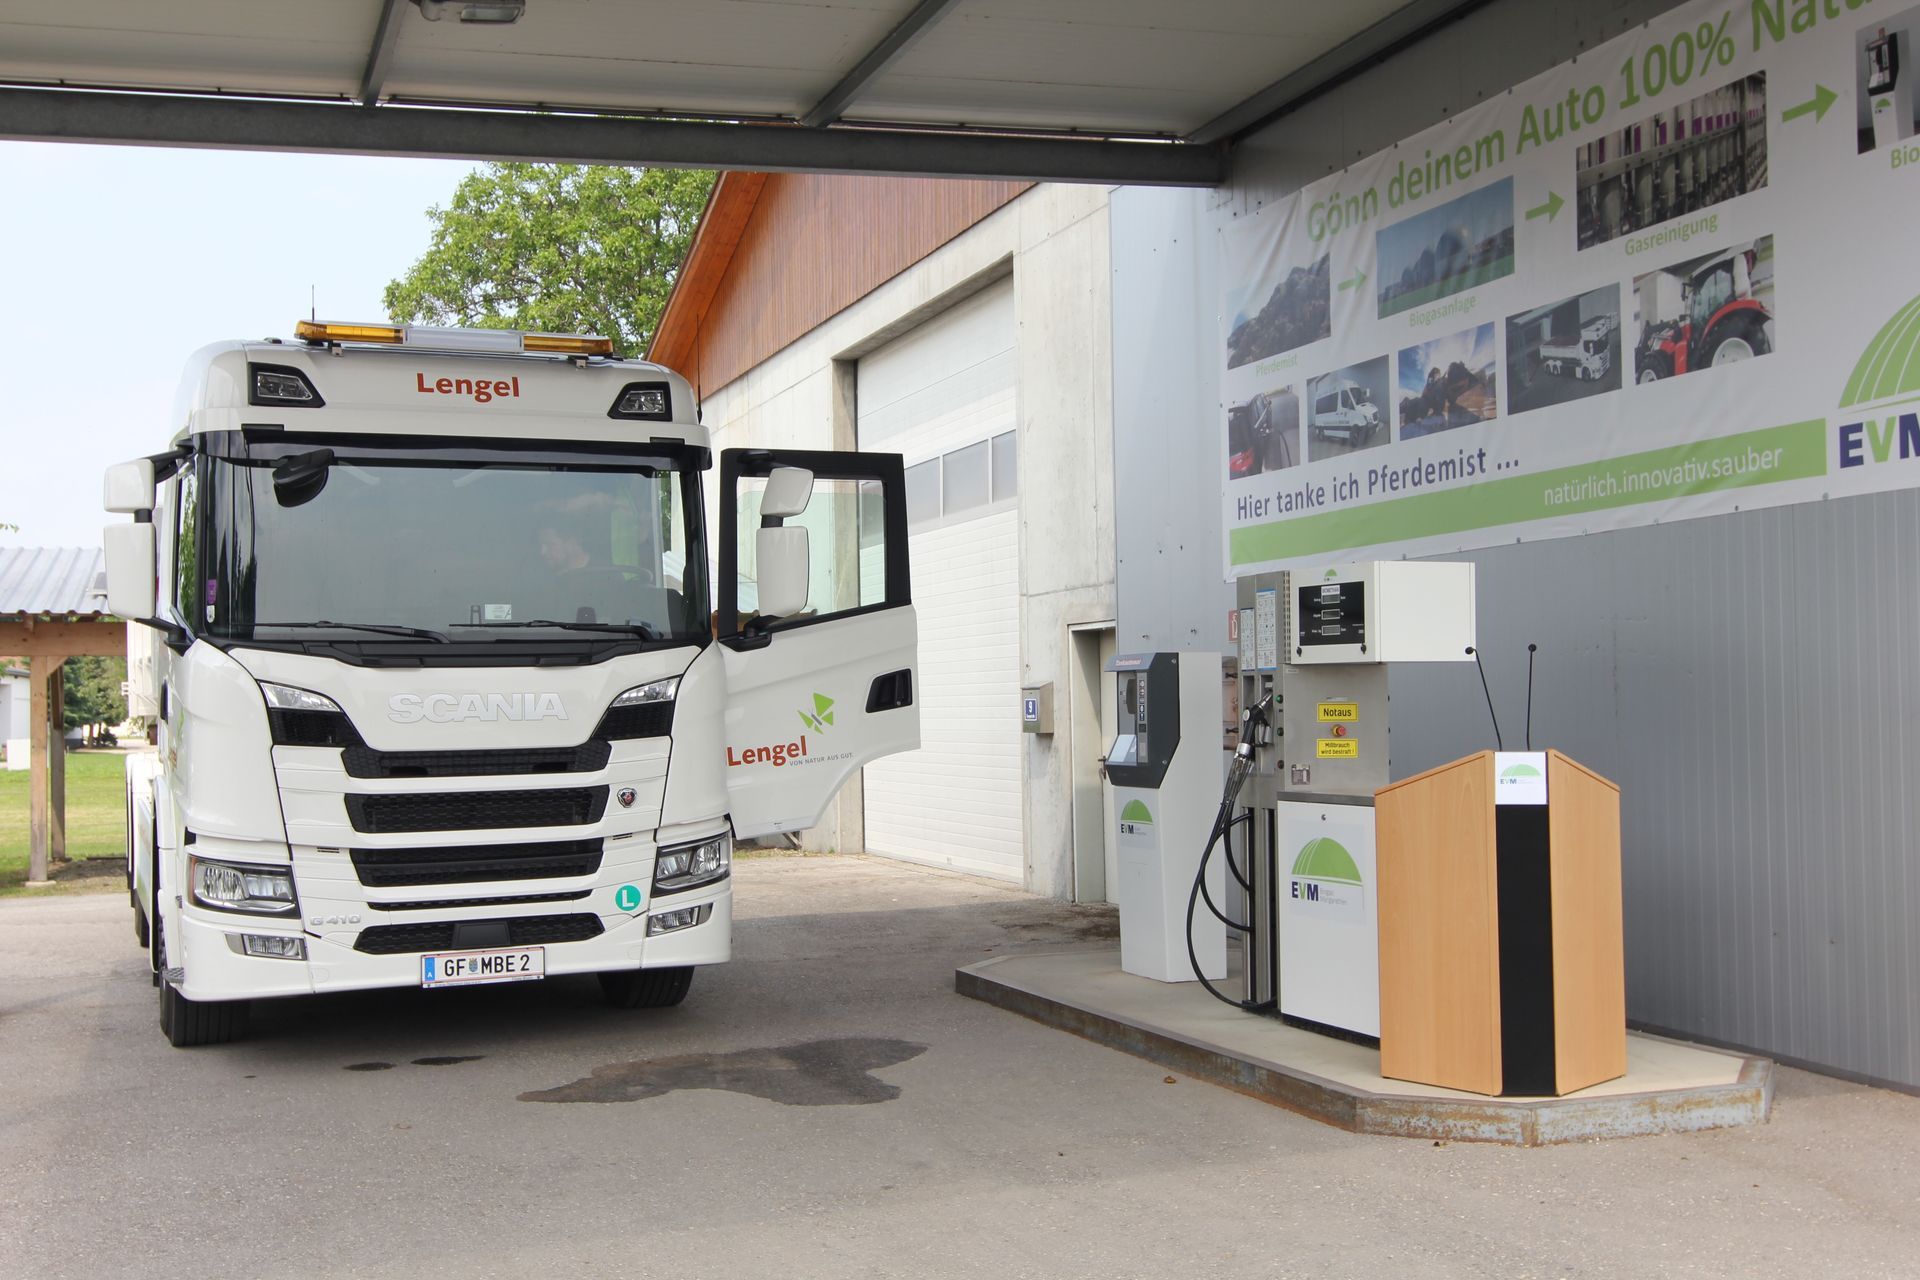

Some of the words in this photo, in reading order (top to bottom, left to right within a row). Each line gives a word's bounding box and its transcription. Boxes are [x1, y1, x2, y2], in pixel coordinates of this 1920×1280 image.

[1307, 186, 1379, 242] Gönn
[1387, 129, 1505, 208] deinem
[1515, 83, 1605, 154] Auto
[1618, 10, 1736, 110] 100%
[1624, 213, 1719, 256] Gasreinigung
[1409, 296, 1477, 328] Biogasanlage
[1255, 352, 1298, 377] Pferdemist
[416, 372, 520, 403] Lengel
[1237, 494, 1270, 520] Hier
[1277, 482, 1325, 513] tanke
[1333, 472, 1359, 502] ich
[1368, 447, 1486, 495] Pferdemist
[1544, 445, 1783, 506] natürlich.innovativ.sauber
[387, 692, 569, 724] SCANIA
[1323, 708, 1352, 717] Notaus
[726, 735, 808, 767] Lengel
[805, 756, 825, 764] NATUR
[622, 890, 634, 907] L
[1291, 881, 1319, 902] EVM
[326, 914, 361, 925] 410
[444, 958, 466, 977] GF
[481, 955, 515, 974] MBE
[520, 954, 530, 971] 2
